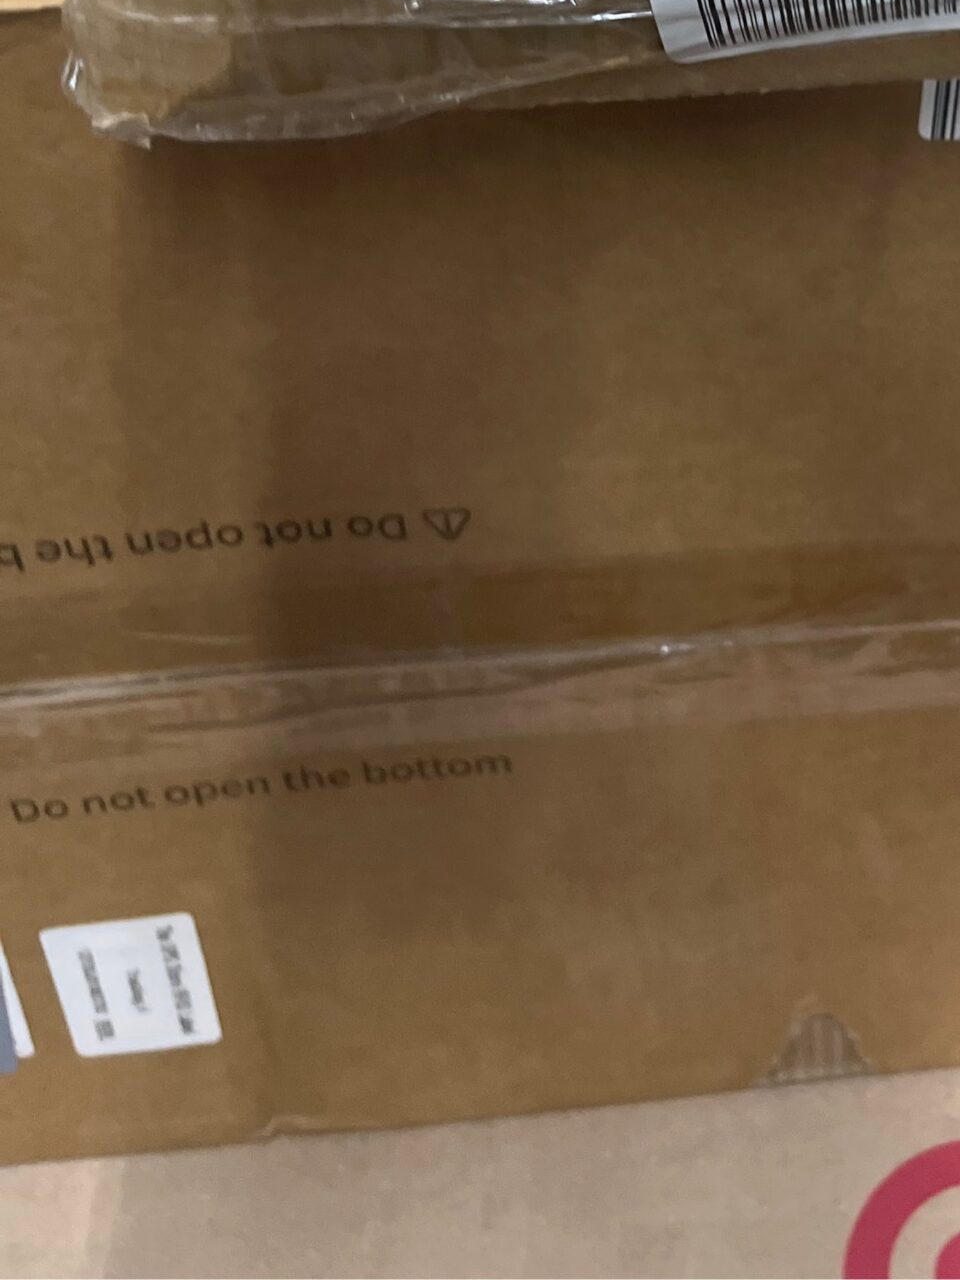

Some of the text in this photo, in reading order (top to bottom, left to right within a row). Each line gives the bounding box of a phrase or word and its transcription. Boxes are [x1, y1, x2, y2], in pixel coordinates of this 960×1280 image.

[127, 519, 244, 557] open
[259, 517, 333, 549] not
[347, 513, 408, 542] Do
[36, 529, 115, 568] the
[9, 752, 514, 824] Do not open the bottom
